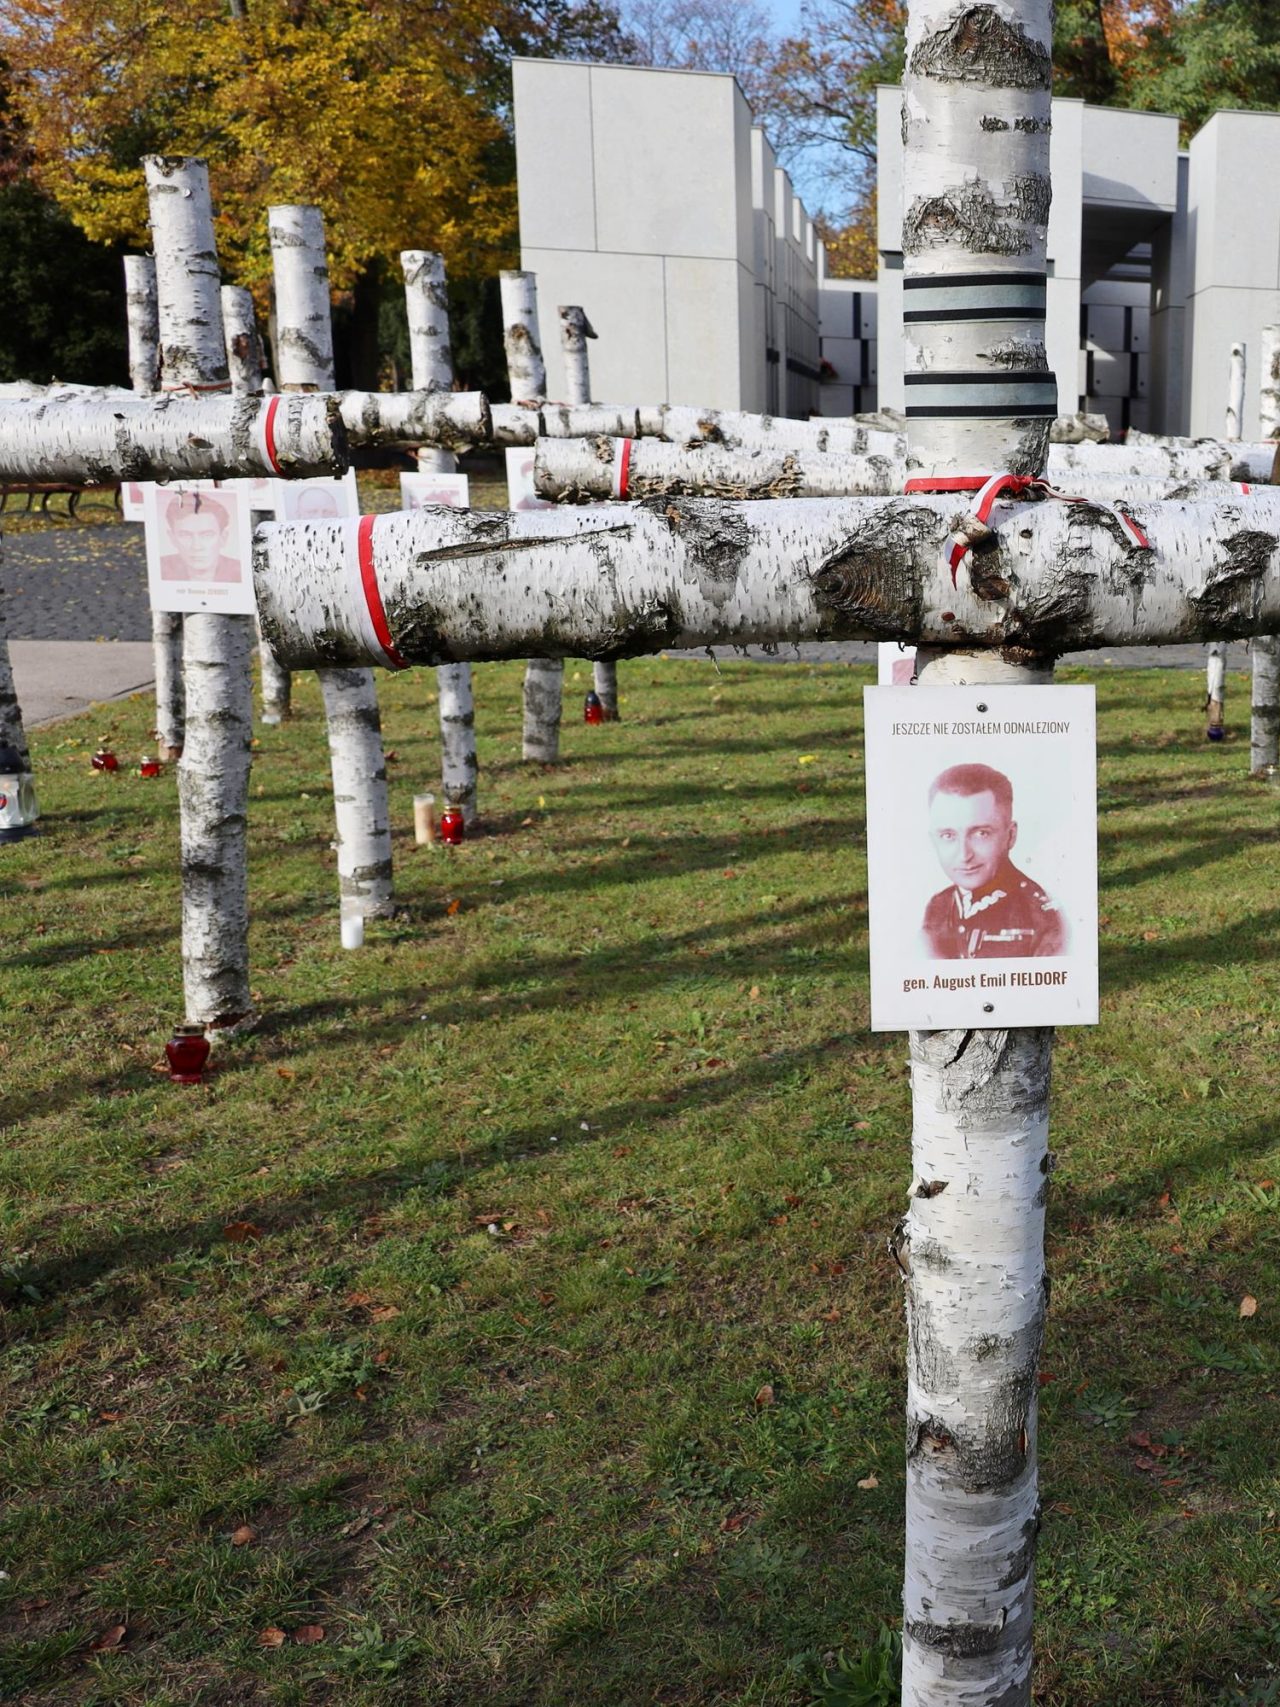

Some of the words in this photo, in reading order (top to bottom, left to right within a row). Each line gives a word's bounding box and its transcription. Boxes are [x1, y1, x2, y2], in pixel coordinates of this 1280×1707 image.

[892, 722, 931, 736] JESZCZE
[933, 722, 949, 735] NIE
[951, 722, 1001, 735] ZOSTAŁEM
[1003, 721, 1070, 735] ODNALEZIONY
[903, 978, 929, 993] gen.
[933, 974, 976, 991] August
[980, 973, 1006, 988] Emil
[1010, 970, 1068, 987] FIELDORF
